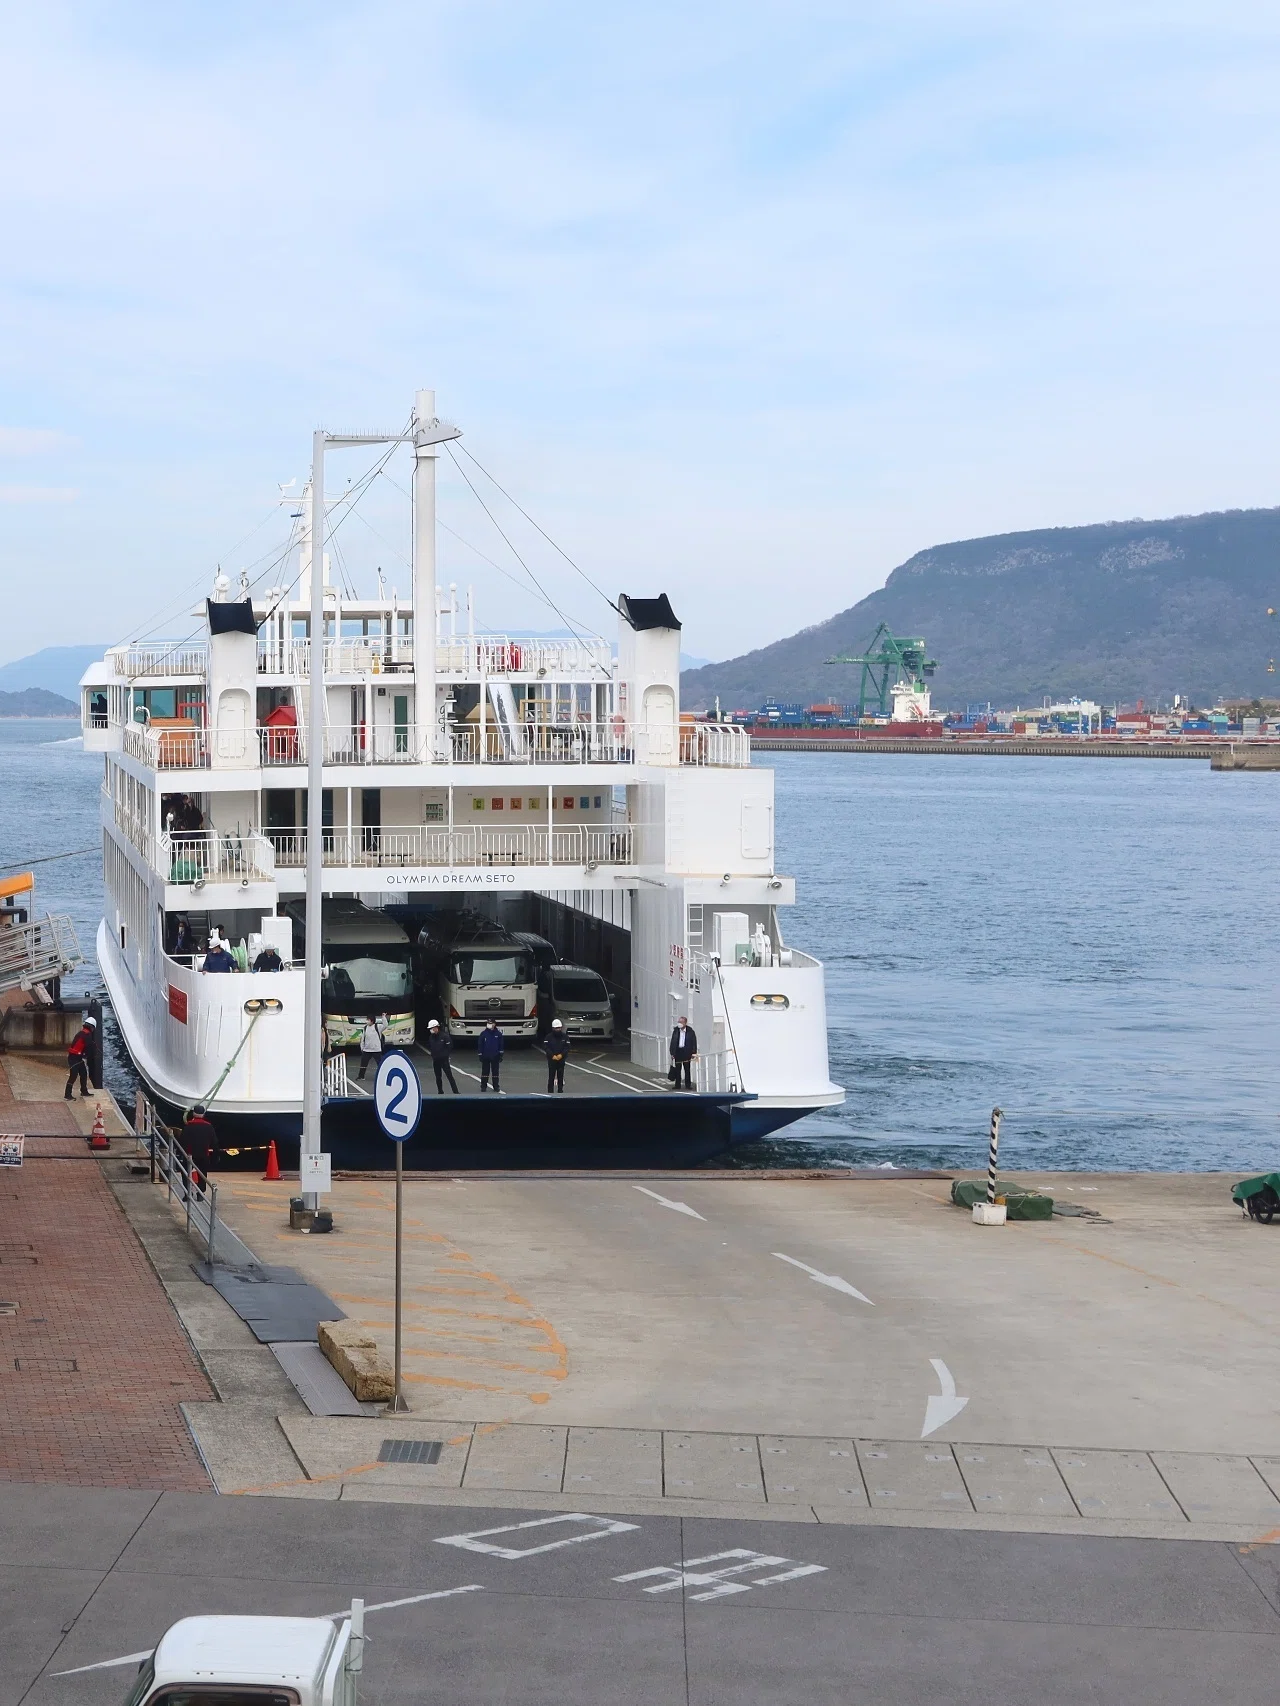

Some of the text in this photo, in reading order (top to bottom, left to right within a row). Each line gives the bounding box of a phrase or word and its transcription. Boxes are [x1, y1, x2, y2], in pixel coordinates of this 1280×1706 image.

[386, 874, 515, 884] OLYMPIA DREAM SETO
[384, 1067, 409, 1124] 2
